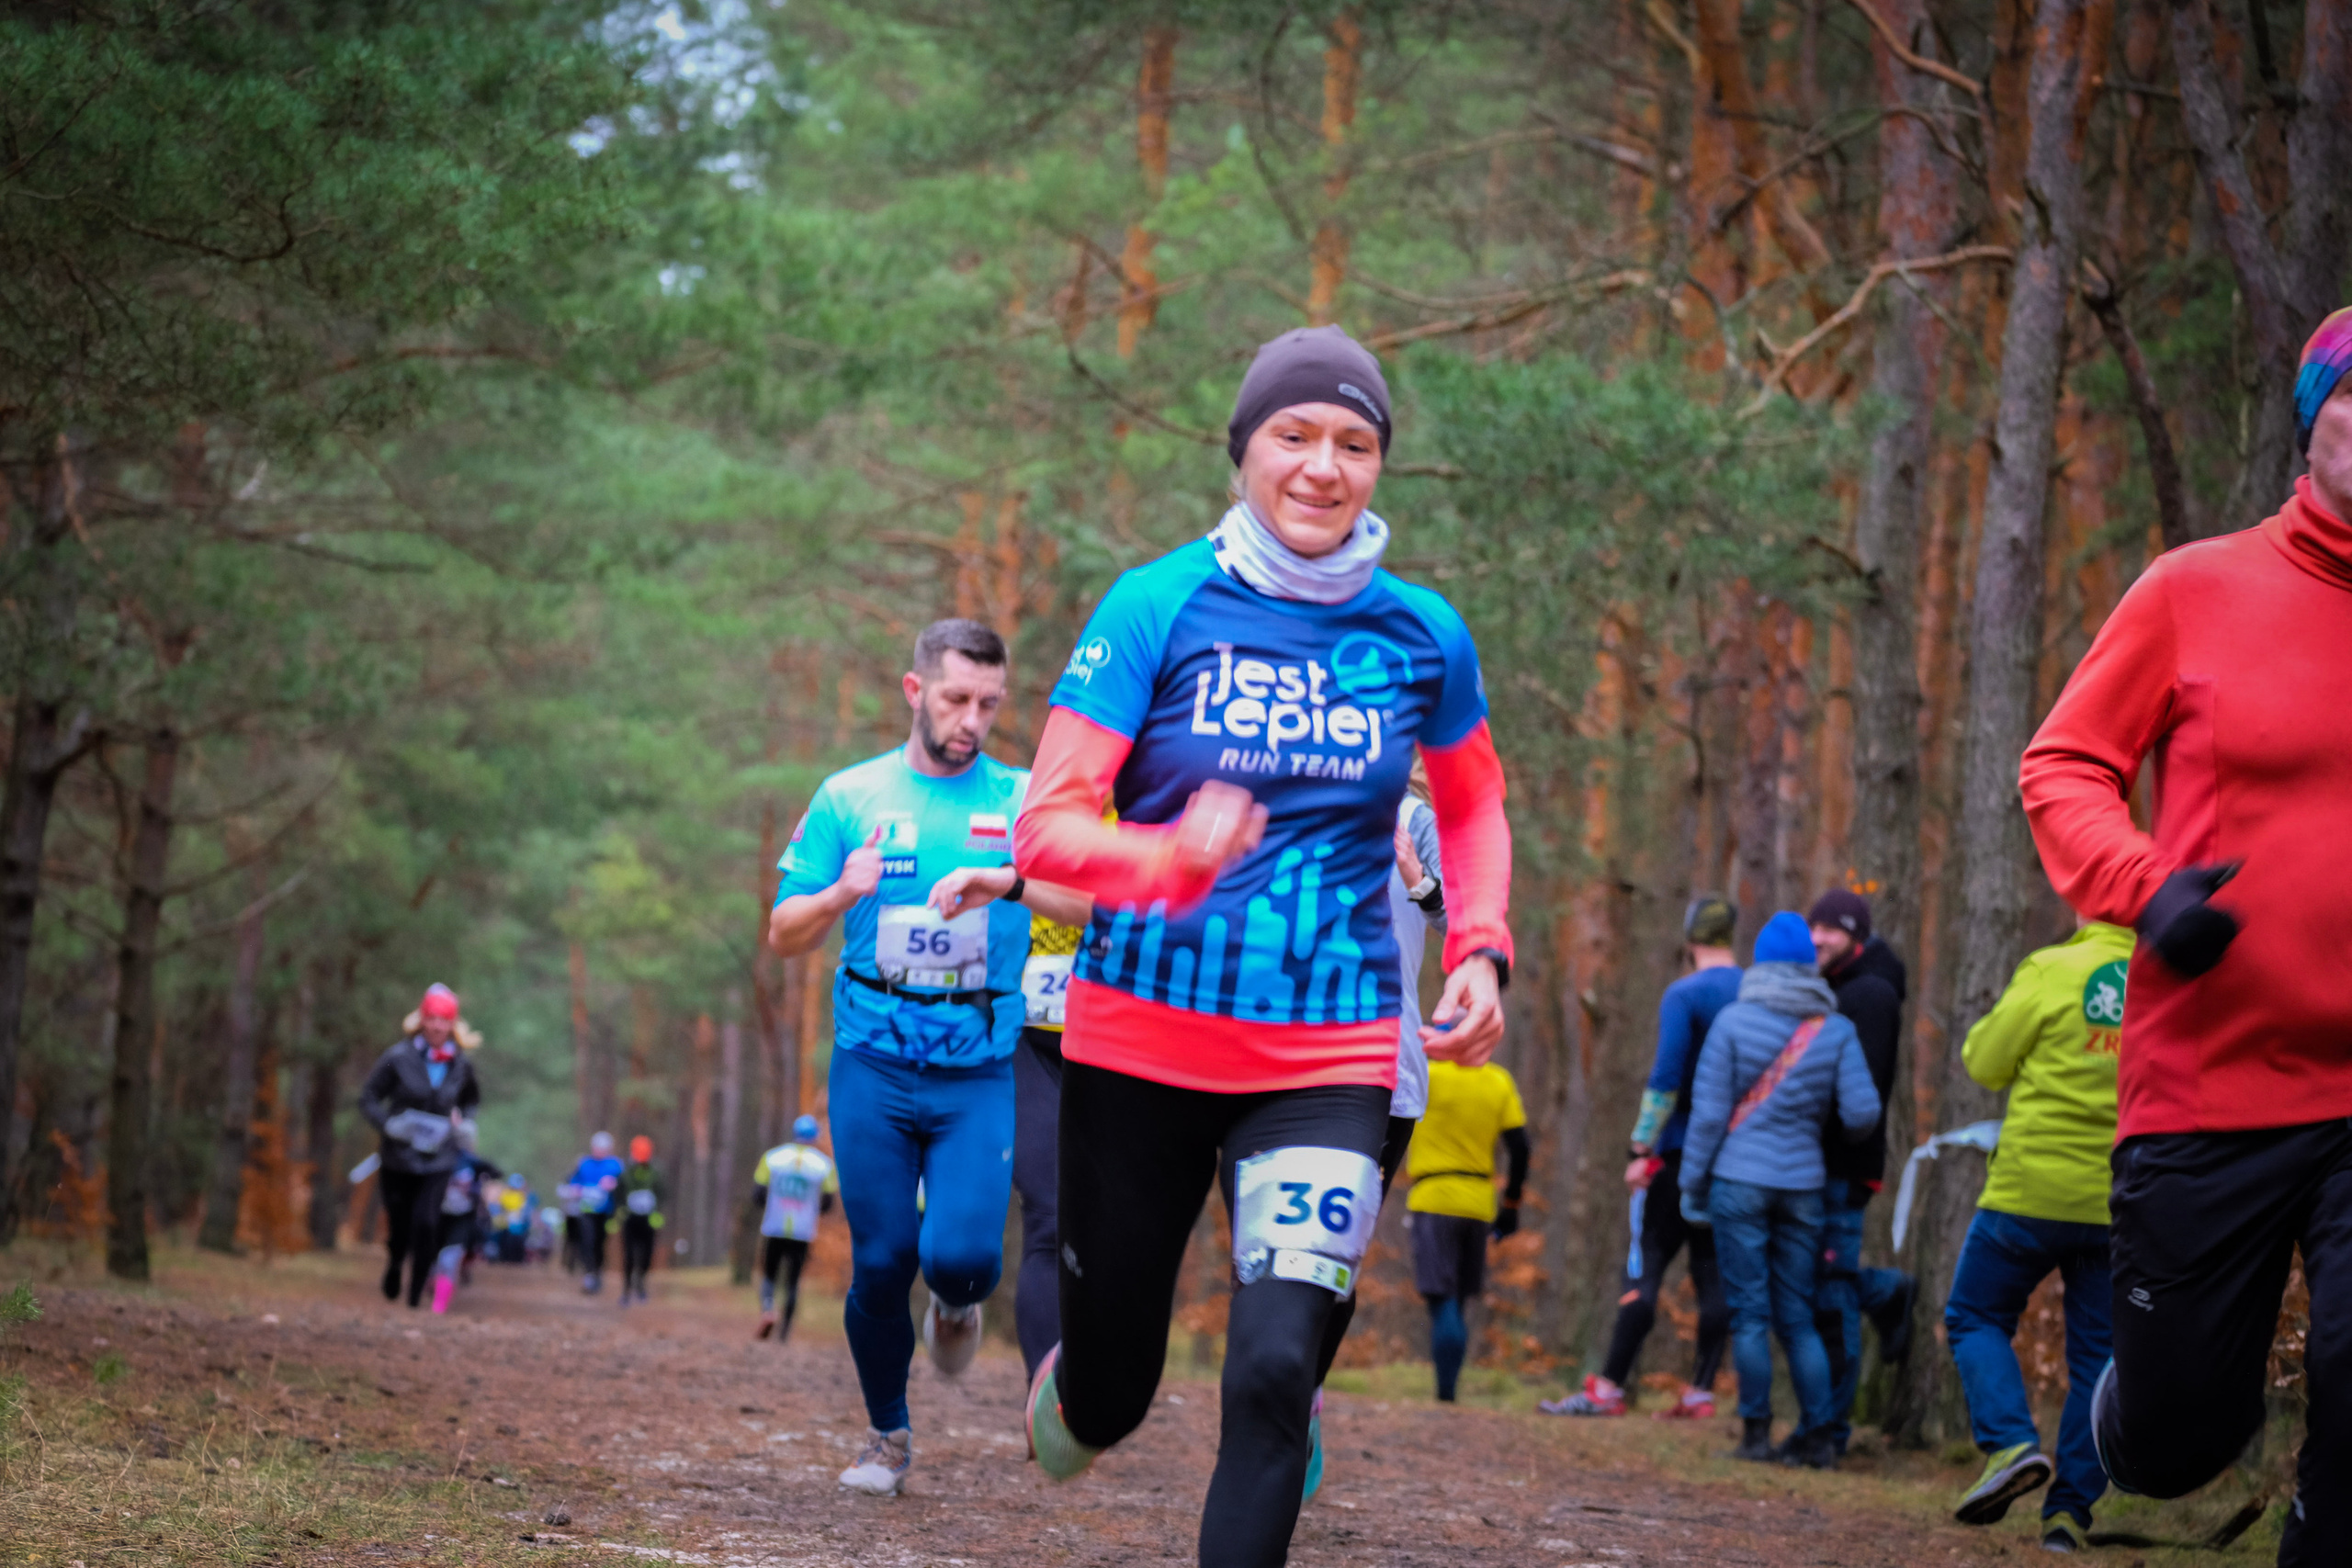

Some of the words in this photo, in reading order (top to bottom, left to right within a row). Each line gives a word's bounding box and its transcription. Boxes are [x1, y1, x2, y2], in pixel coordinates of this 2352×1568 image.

[1211, 640, 1328, 707] Jest
[1192, 670, 1382, 764] Lepiej
[1217, 747, 1281, 775] RUN
[1290, 752, 1366, 782] TEAM
[906, 927, 951, 956] 56
[1273, 1181, 1354, 1235] 36
